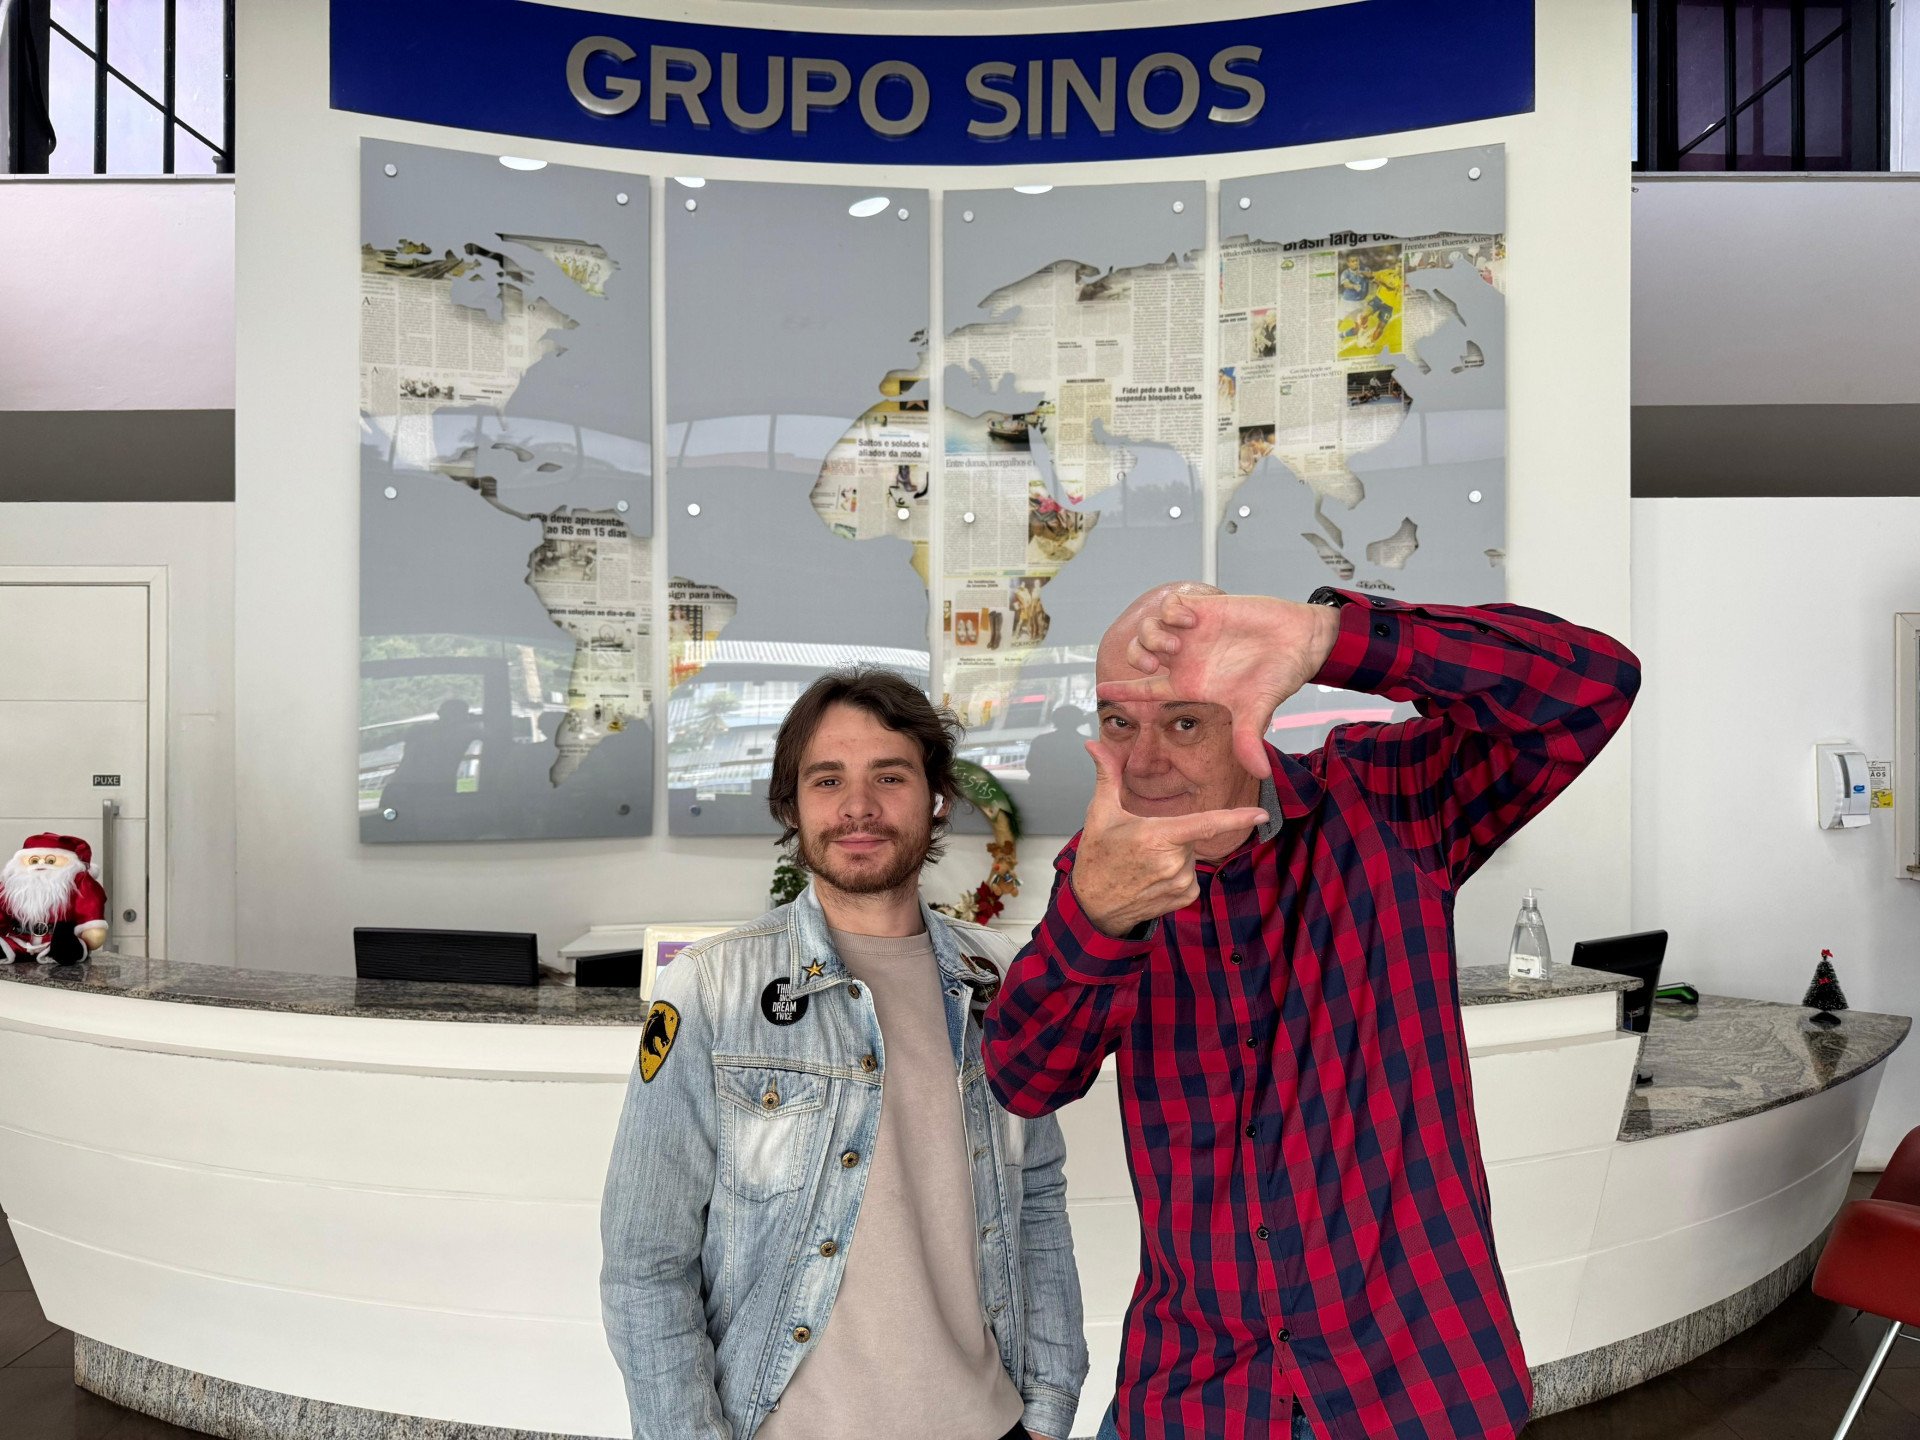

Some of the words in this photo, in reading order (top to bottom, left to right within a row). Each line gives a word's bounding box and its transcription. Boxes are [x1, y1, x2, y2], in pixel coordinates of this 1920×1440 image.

[565, 35, 931, 136] GRUPO
[965, 44, 1266, 138] SINOS
[1329, 232, 1367, 247] larga
[1441, 239, 1470, 247] Buenos
[1471, 235, 1493, 244] Aires
[1140, 387, 1157, 396] pede
[1182, 386, 1195, 394] que
[891, 440, 920, 448] solados
[858, 449, 887, 457] aliados
[900, 450, 922, 458] moda
[550, 514, 573, 524] deve
[546, 526, 558, 534] ao
[561, 526, 574, 535] RS
[594, 528, 605, 537] 15
[608, 529, 628, 538] dias
[688, 591, 710, 600] para
[94, 776, 120, 785] PUXE
[772, 1001, 797, 1012] DREAM
[776, 1012, 793, 1021] TWICE
